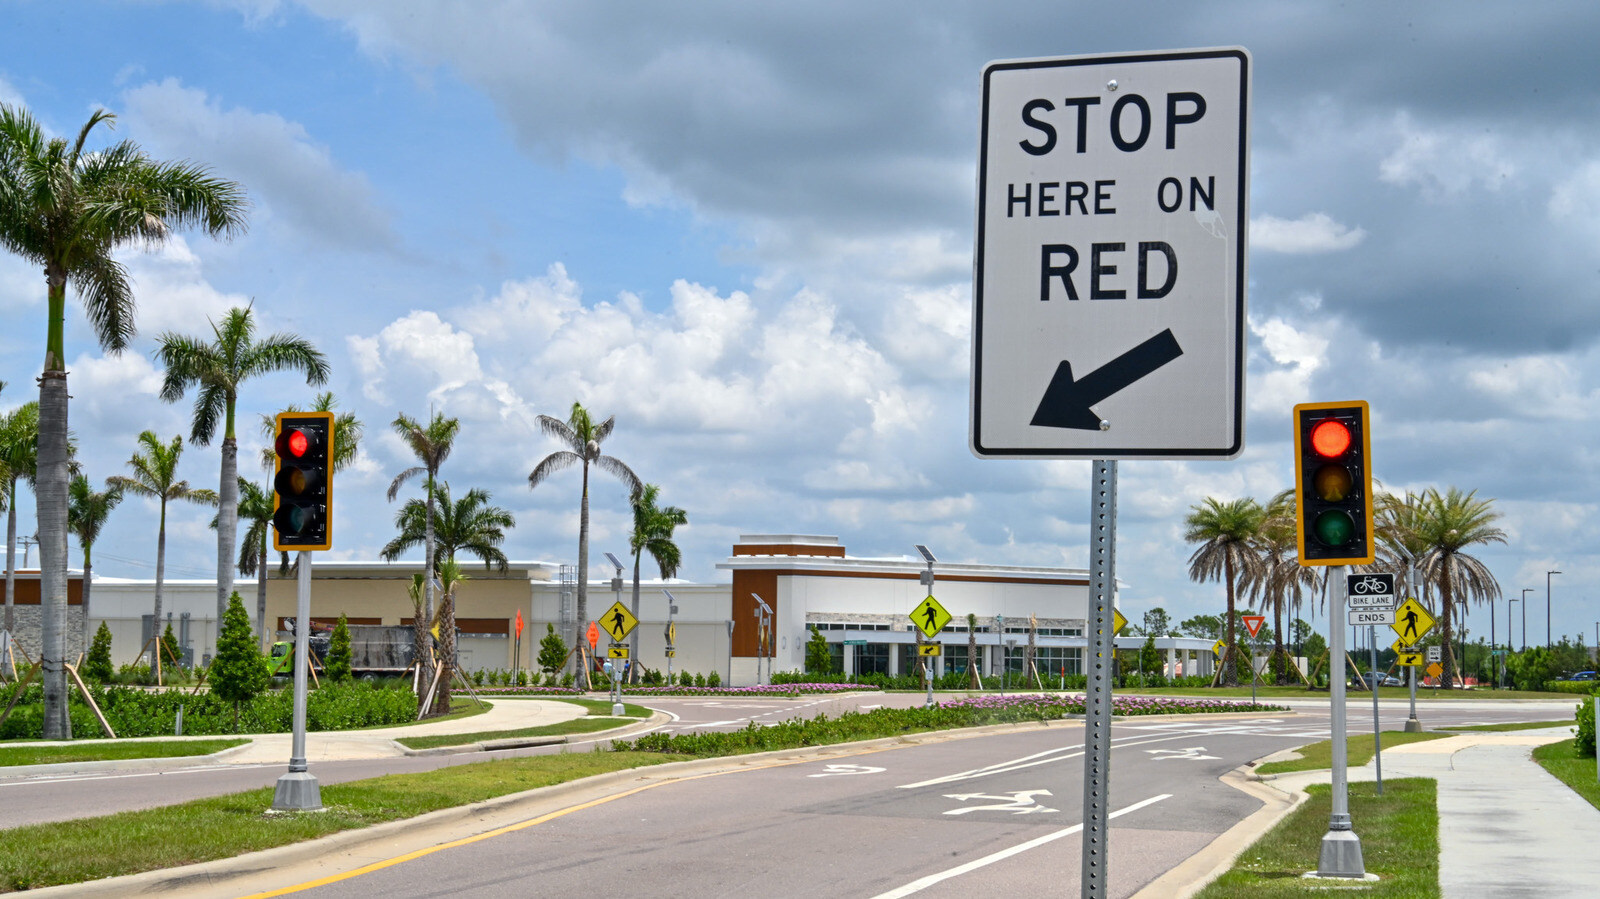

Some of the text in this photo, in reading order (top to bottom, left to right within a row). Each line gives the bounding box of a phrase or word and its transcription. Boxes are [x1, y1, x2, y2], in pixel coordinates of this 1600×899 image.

[1019, 92, 1207, 156] STOP
[1007, 176, 1215, 217] HERE ON
[1040, 241, 1179, 301] RED
[1353, 596, 1390, 605] BIKE LANE
[1358, 614, 1385, 622] ENDS
